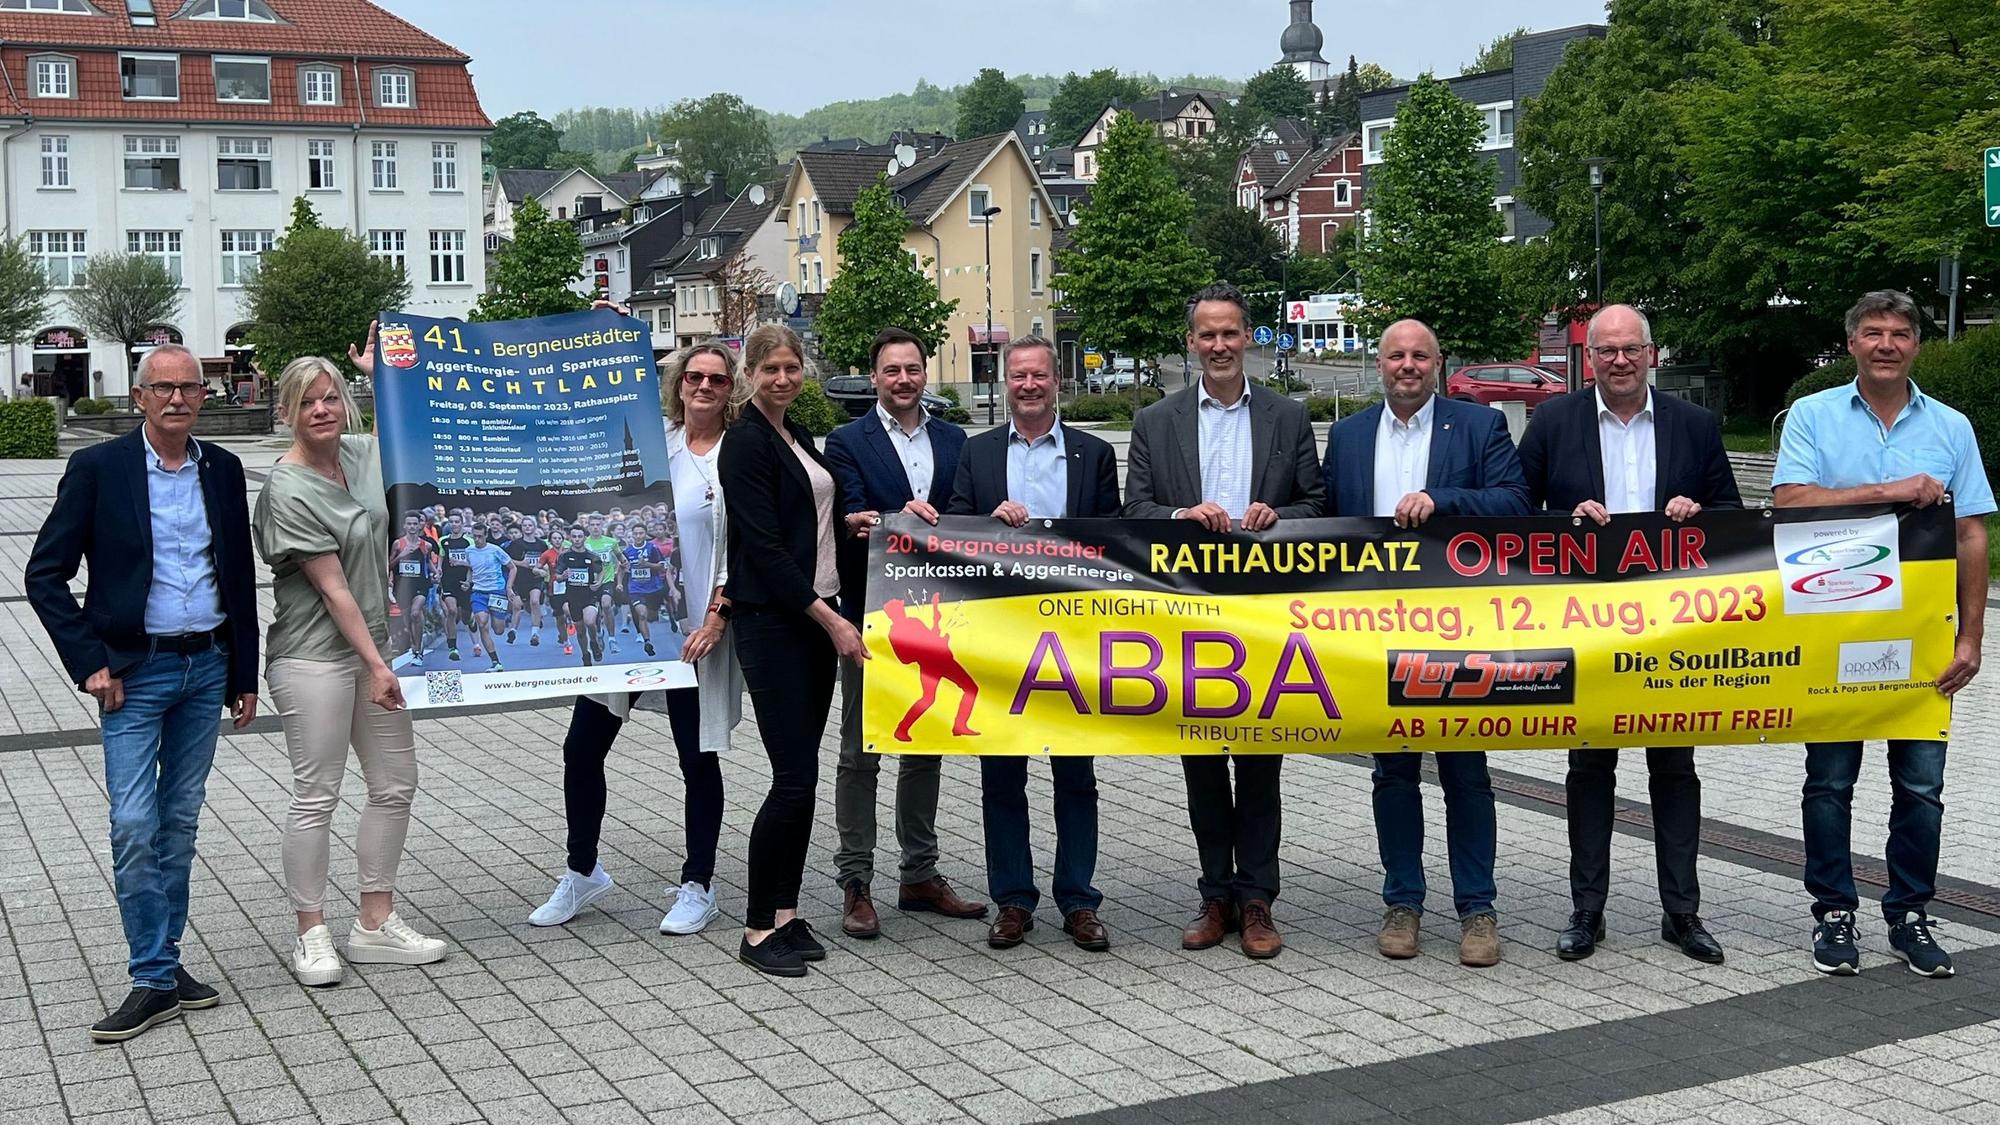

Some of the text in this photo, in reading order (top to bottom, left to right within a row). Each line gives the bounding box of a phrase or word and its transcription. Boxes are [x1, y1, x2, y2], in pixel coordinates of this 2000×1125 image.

[424, 325, 640, 358] 41. Bergneustädter
[426, 354, 644, 378] AggerEnergie- und Sparkassen-
[430, 400, 467, 411] Freitag,
[489, 402, 541, 412] September
[544, 402, 572, 411] 2023,
[574, 392, 638, 409] Rathausplatz
[1814, 528, 1847, 538] powered
[886, 535, 1106, 560] 20. Bergneustädter
[1151, 526, 1709, 576] RATHAUSPLATZ OPEN AIR
[885, 562, 1134, 582] Sparkassen & AggerEnergie
[1038, 598, 1220, 616] ONE NIGHT WITH
[1290, 584, 1767, 640] Samstag, 12. Aug. 2023
[1614, 646, 1801, 673] Die SoulBand
[484, 675, 598, 690] www.bergneustadt.de
[1009, 631, 1342, 720] ABBA
[1643, 673, 1770, 690] Aus der Region
[1842, 686, 1858, 694] Pop
[1388, 716, 1578, 738] AB 17.00 UHR
[1613, 708, 1794, 734] EINTRITT FREI!
[1176, 724, 1342, 742] TRIBUTE SHOW
